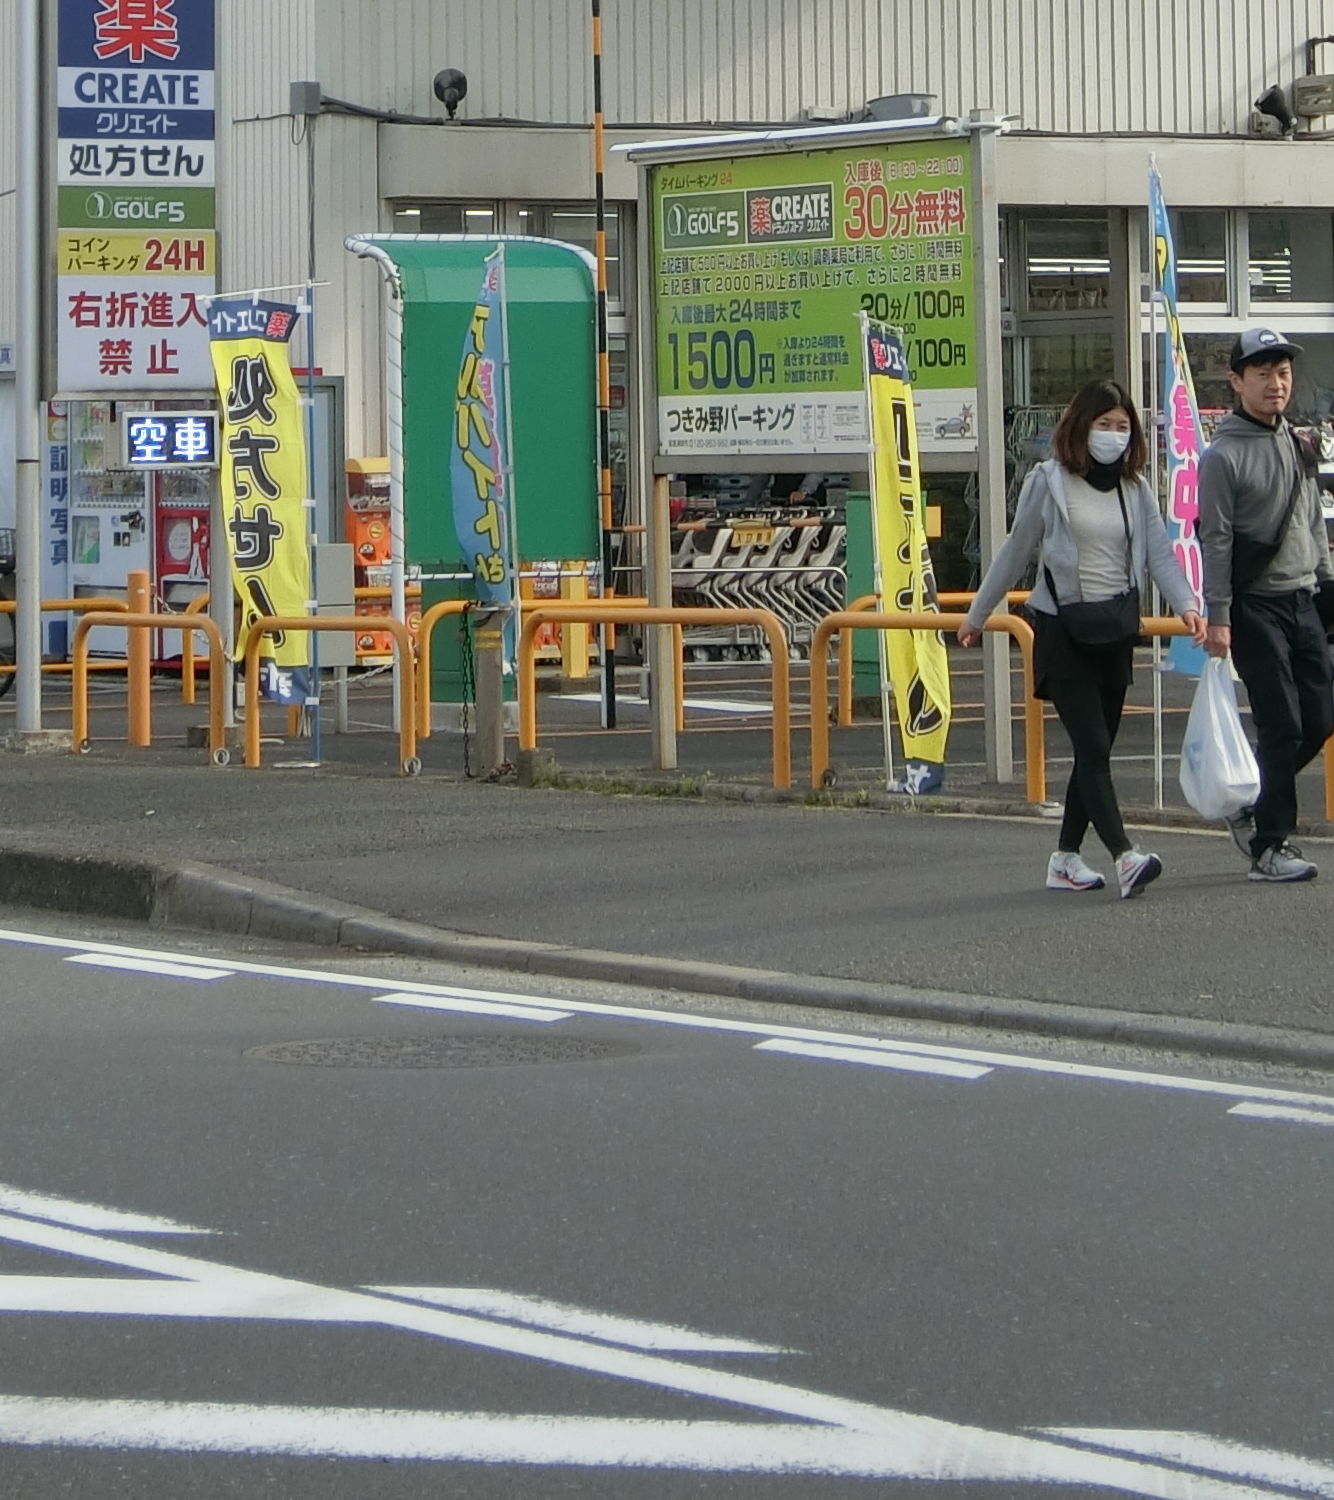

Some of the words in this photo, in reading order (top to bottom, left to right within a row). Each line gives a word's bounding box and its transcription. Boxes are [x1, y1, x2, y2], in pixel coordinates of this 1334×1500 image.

[74, 72, 199, 106] CREATE
[96, 112, 178, 135] クリエイト
[69, 143, 204, 177] 処方せん
[113, 200, 185, 223] GOLF5
[688, 210, 739, 237] GOLF5
[750, 197, 772, 236] 薬
[771, 193, 830, 221] CREATE
[844, 185, 966, 240] 30分無料
[67, 237, 111, 254] コイン
[67, 253, 140, 272] パーキング
[144, 239, 205, 272] 24H
[68, 292, 209, 329] 右折進入
[98, 338, 179, 375] 禁止
[668, 329, 775, 390] 1500円
[667, 404, 796, 433] つきみ野パーキング
[130, 417, 210, 461] 空車
